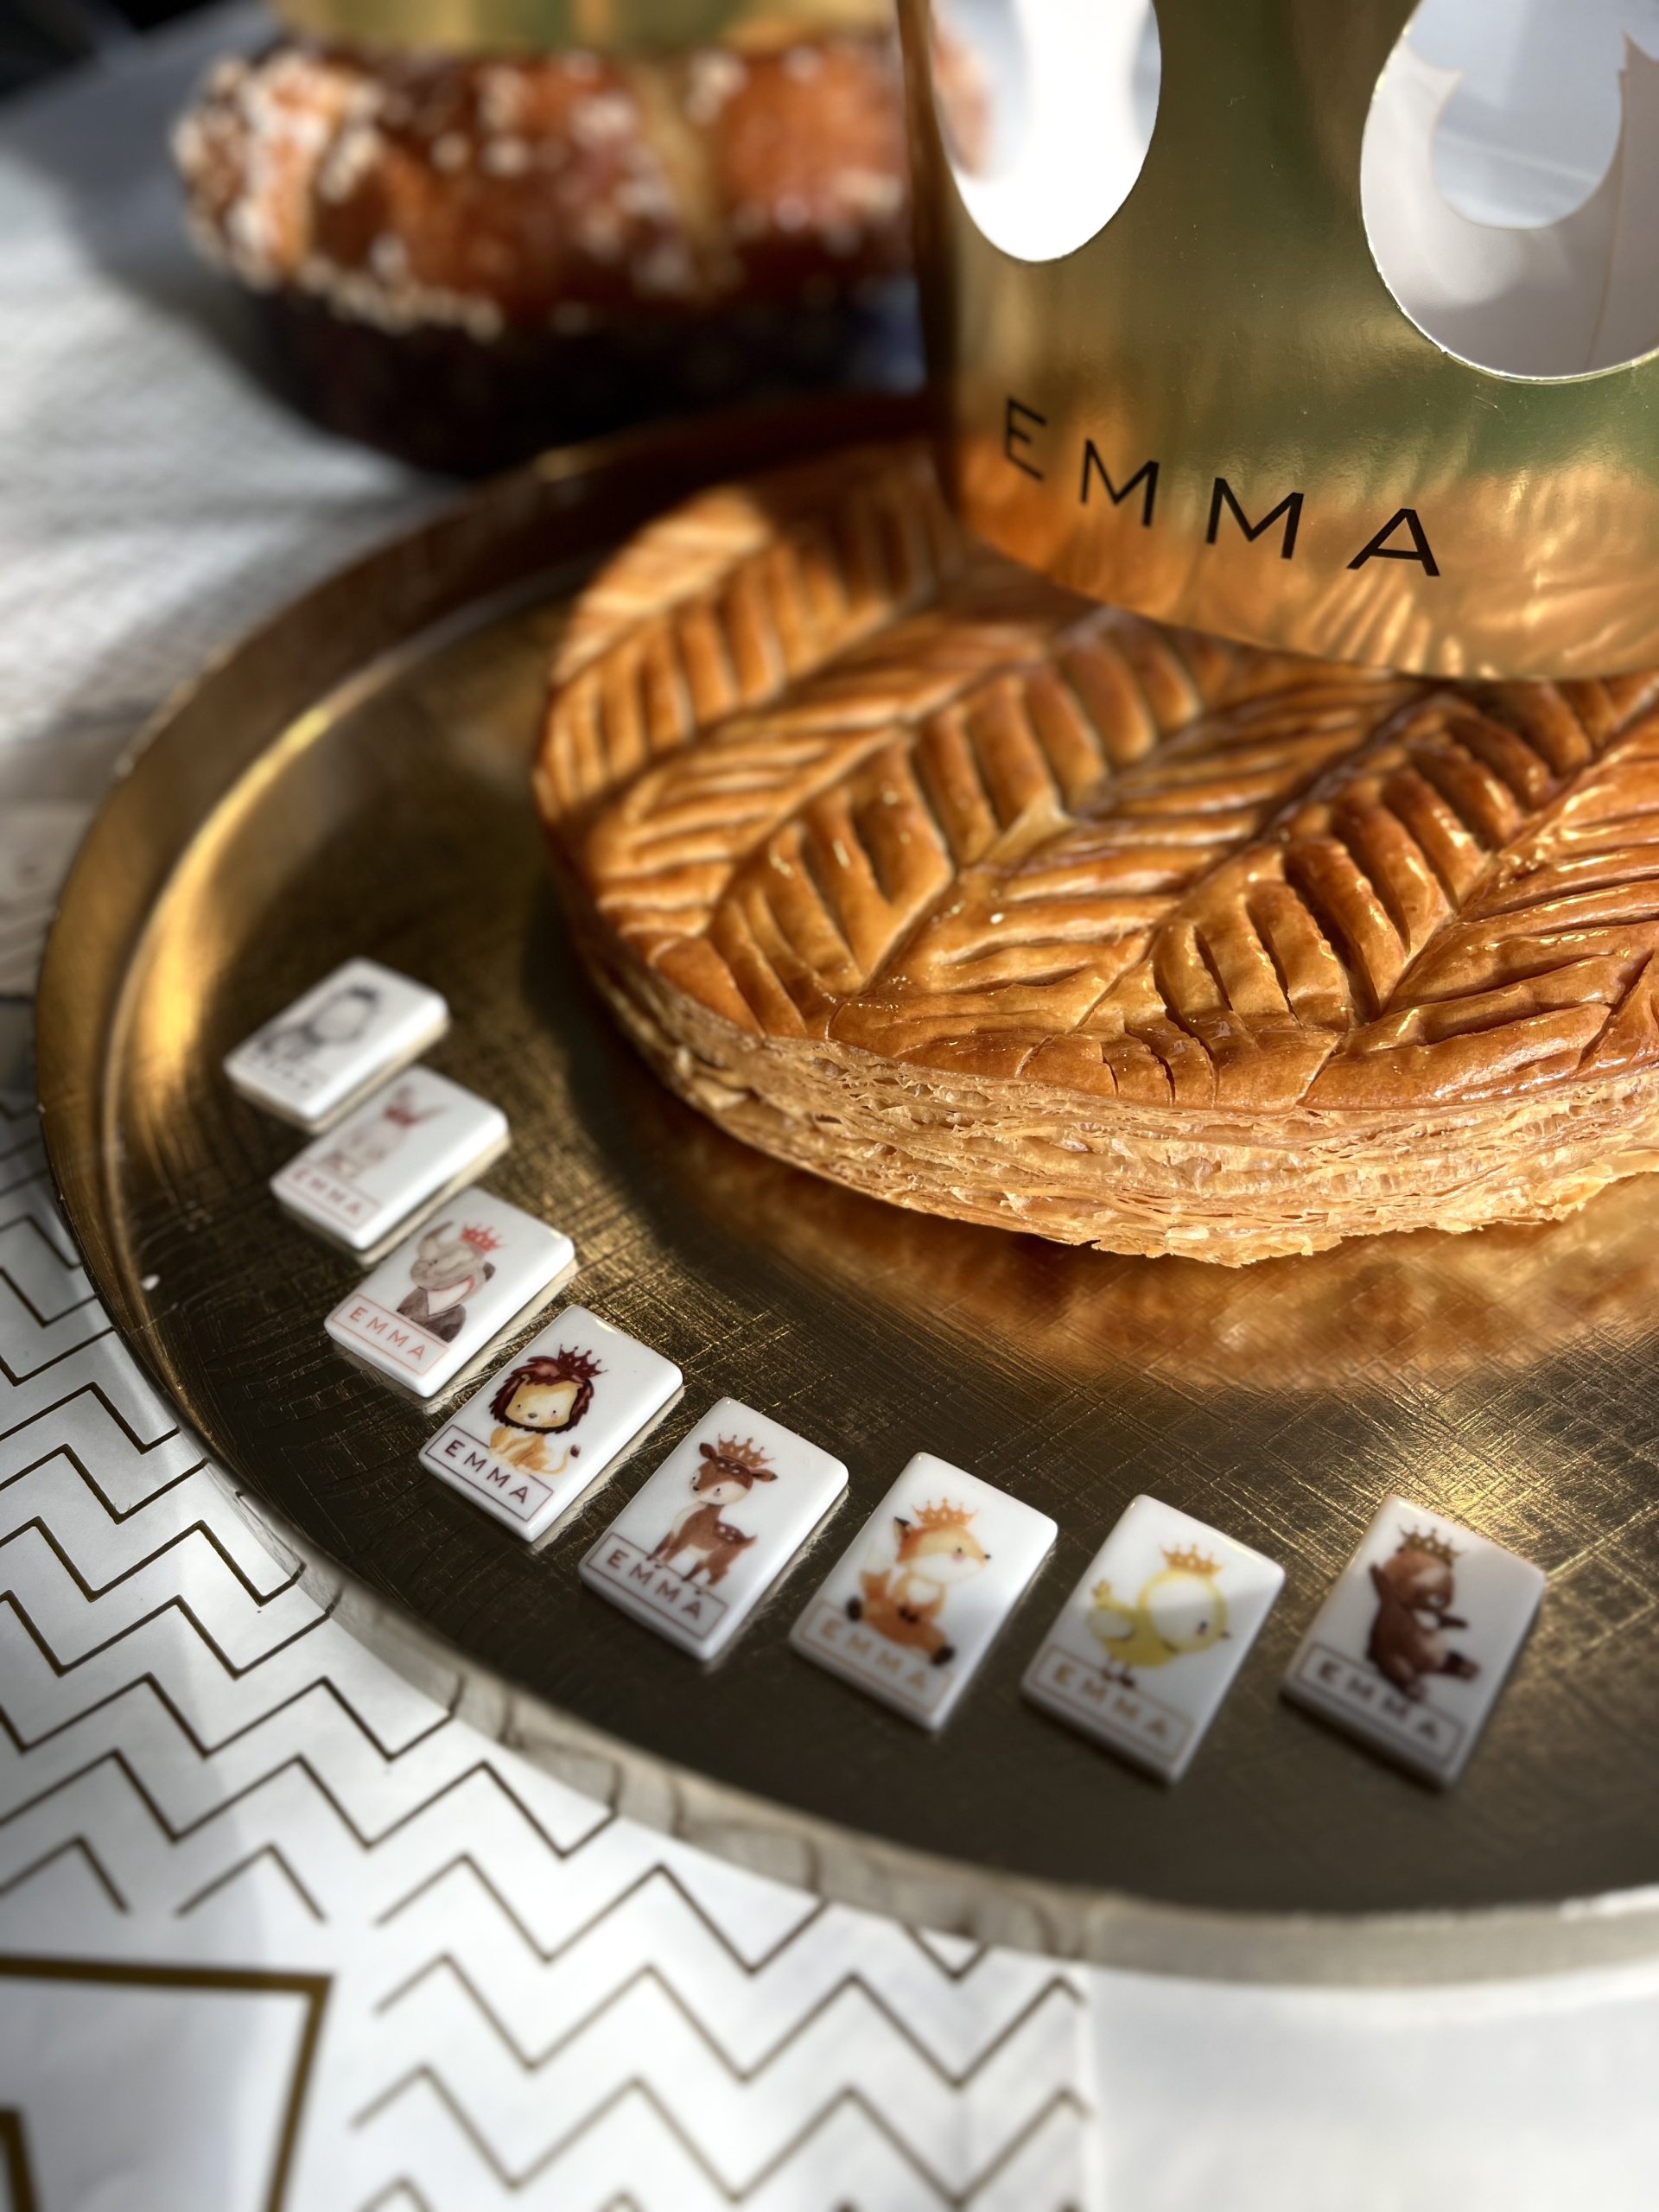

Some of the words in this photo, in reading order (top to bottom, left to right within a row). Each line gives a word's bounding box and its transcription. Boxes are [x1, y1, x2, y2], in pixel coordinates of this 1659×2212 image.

[1004, 396, 1440, 577] EMMA
[291, 1166, 361, 1217] EMMA
[348, 1306, 428, 1361] EMMA
[444, 1439, 530, 1505] EMMA
[607, 1548, 703, 1621] EMMA
[820, 1619, 929, 1690] EMMA
[1052, 1663, 1169, 1740] EMMA
[1316, 1661, 1440, 1742] EMMA
